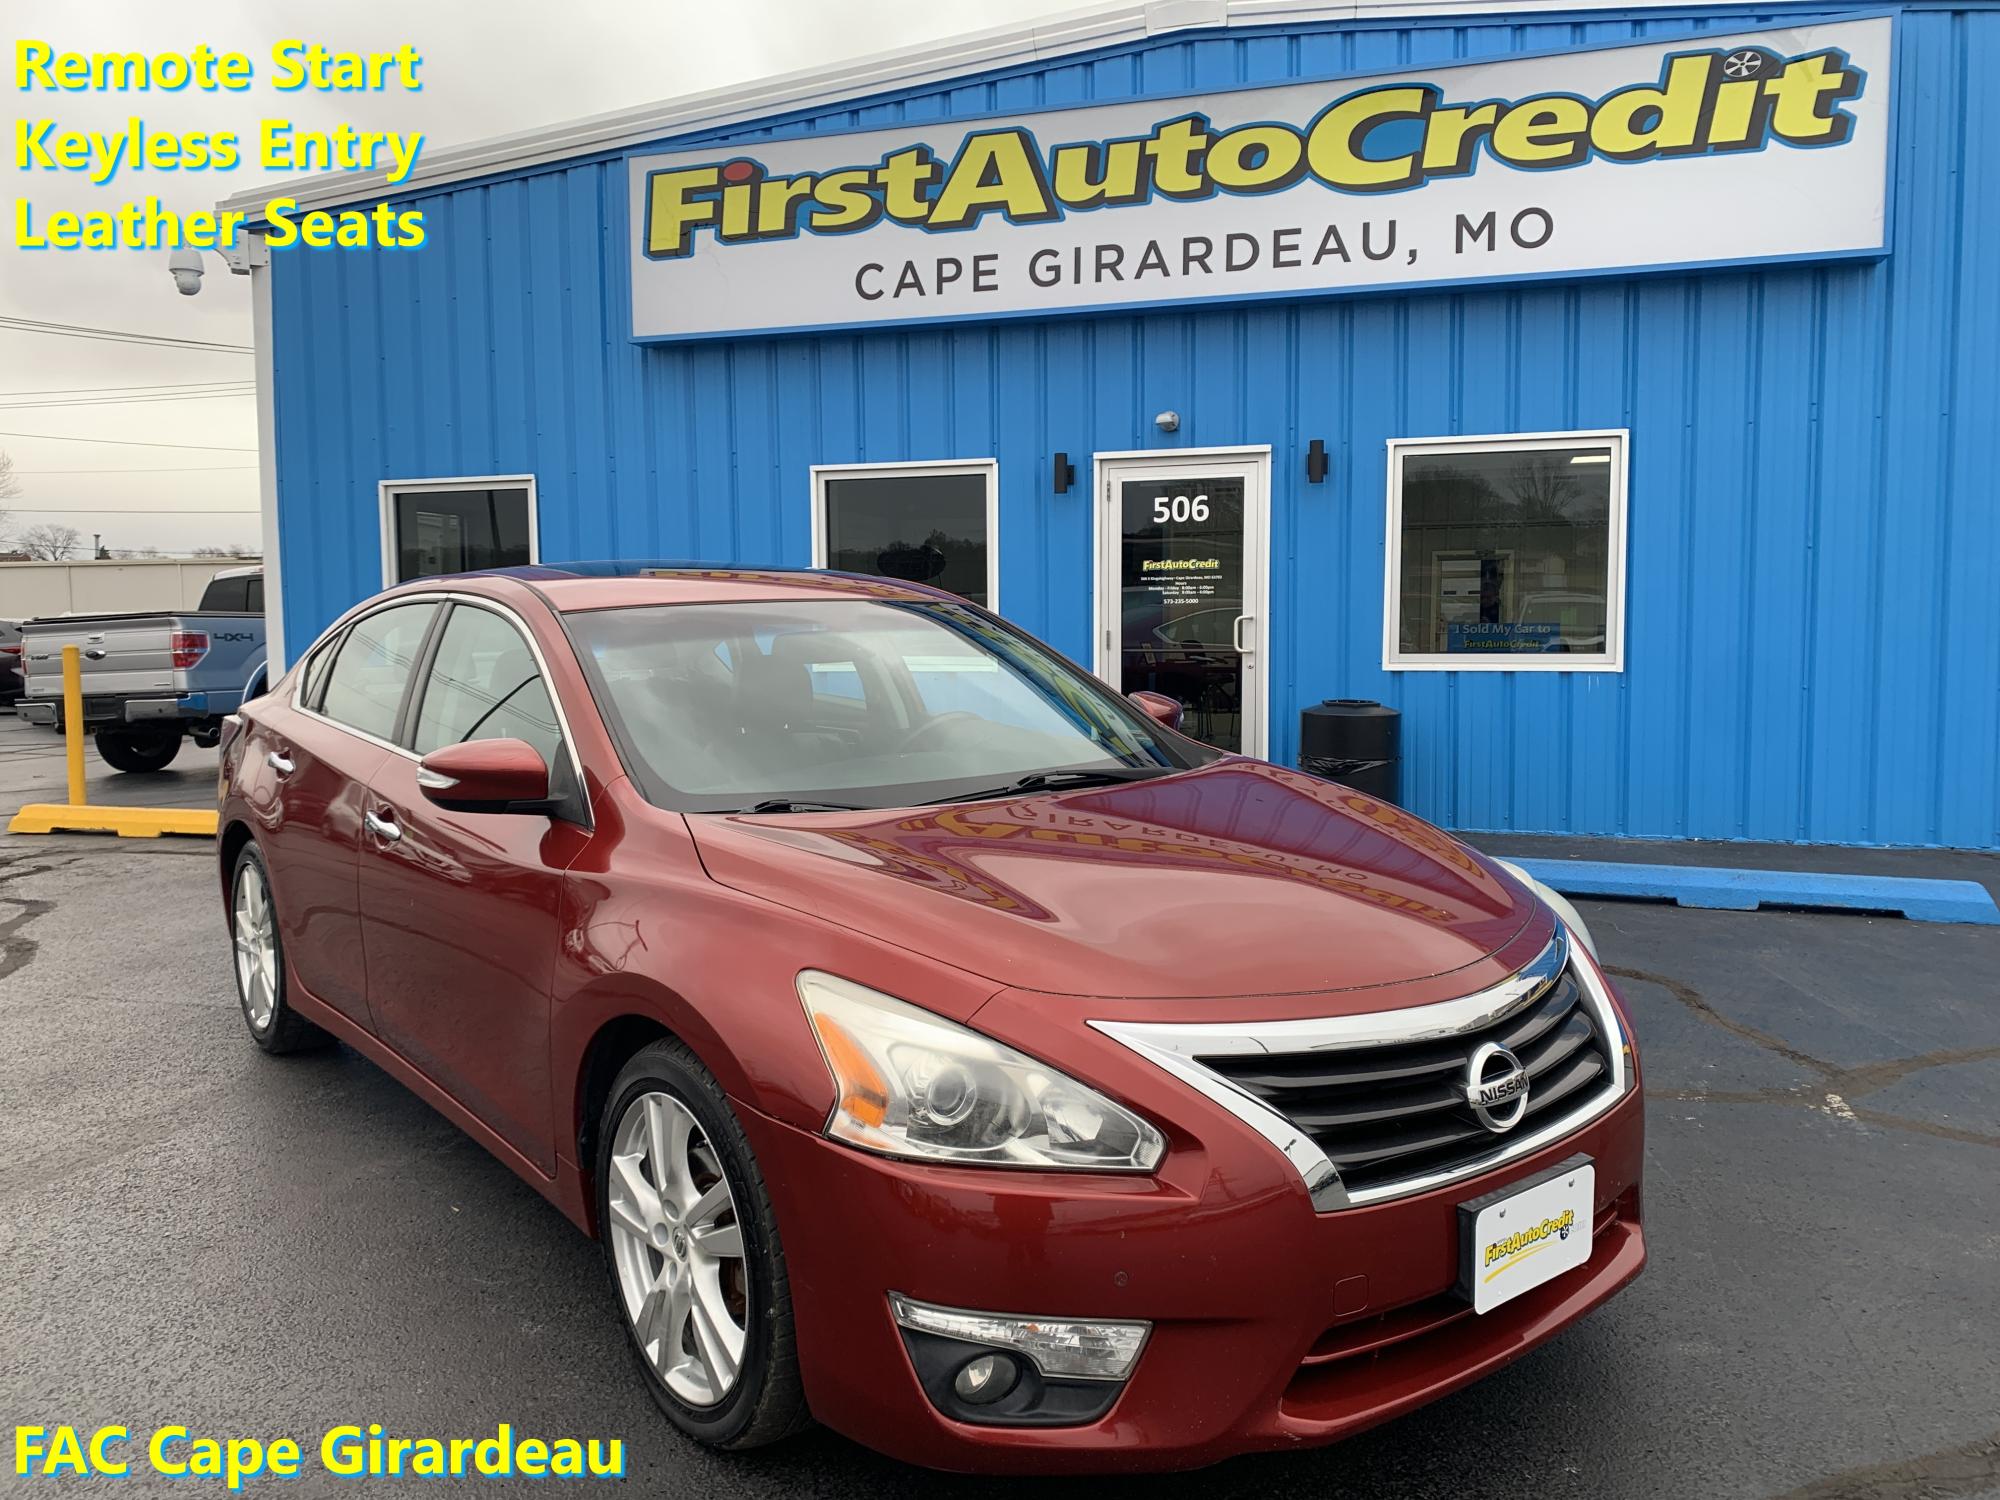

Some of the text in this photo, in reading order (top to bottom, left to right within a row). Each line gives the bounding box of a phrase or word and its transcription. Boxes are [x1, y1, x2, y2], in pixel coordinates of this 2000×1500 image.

[644, 48, 1866, 260] FirstAutoCredit
[855, 207, 1554, 301] CAPE GIRARDEAU, MO
[1153, 495, 1210, 523] 506
[1143, 558, 1220, 572] FirstAutoCredit
[1455, 624, 1551, 636] I Sold My Car to
[1479, 1074, 1529, 1103] NISSAN
[1484, 1209, 1574, 1267] FirstAutoCredit
